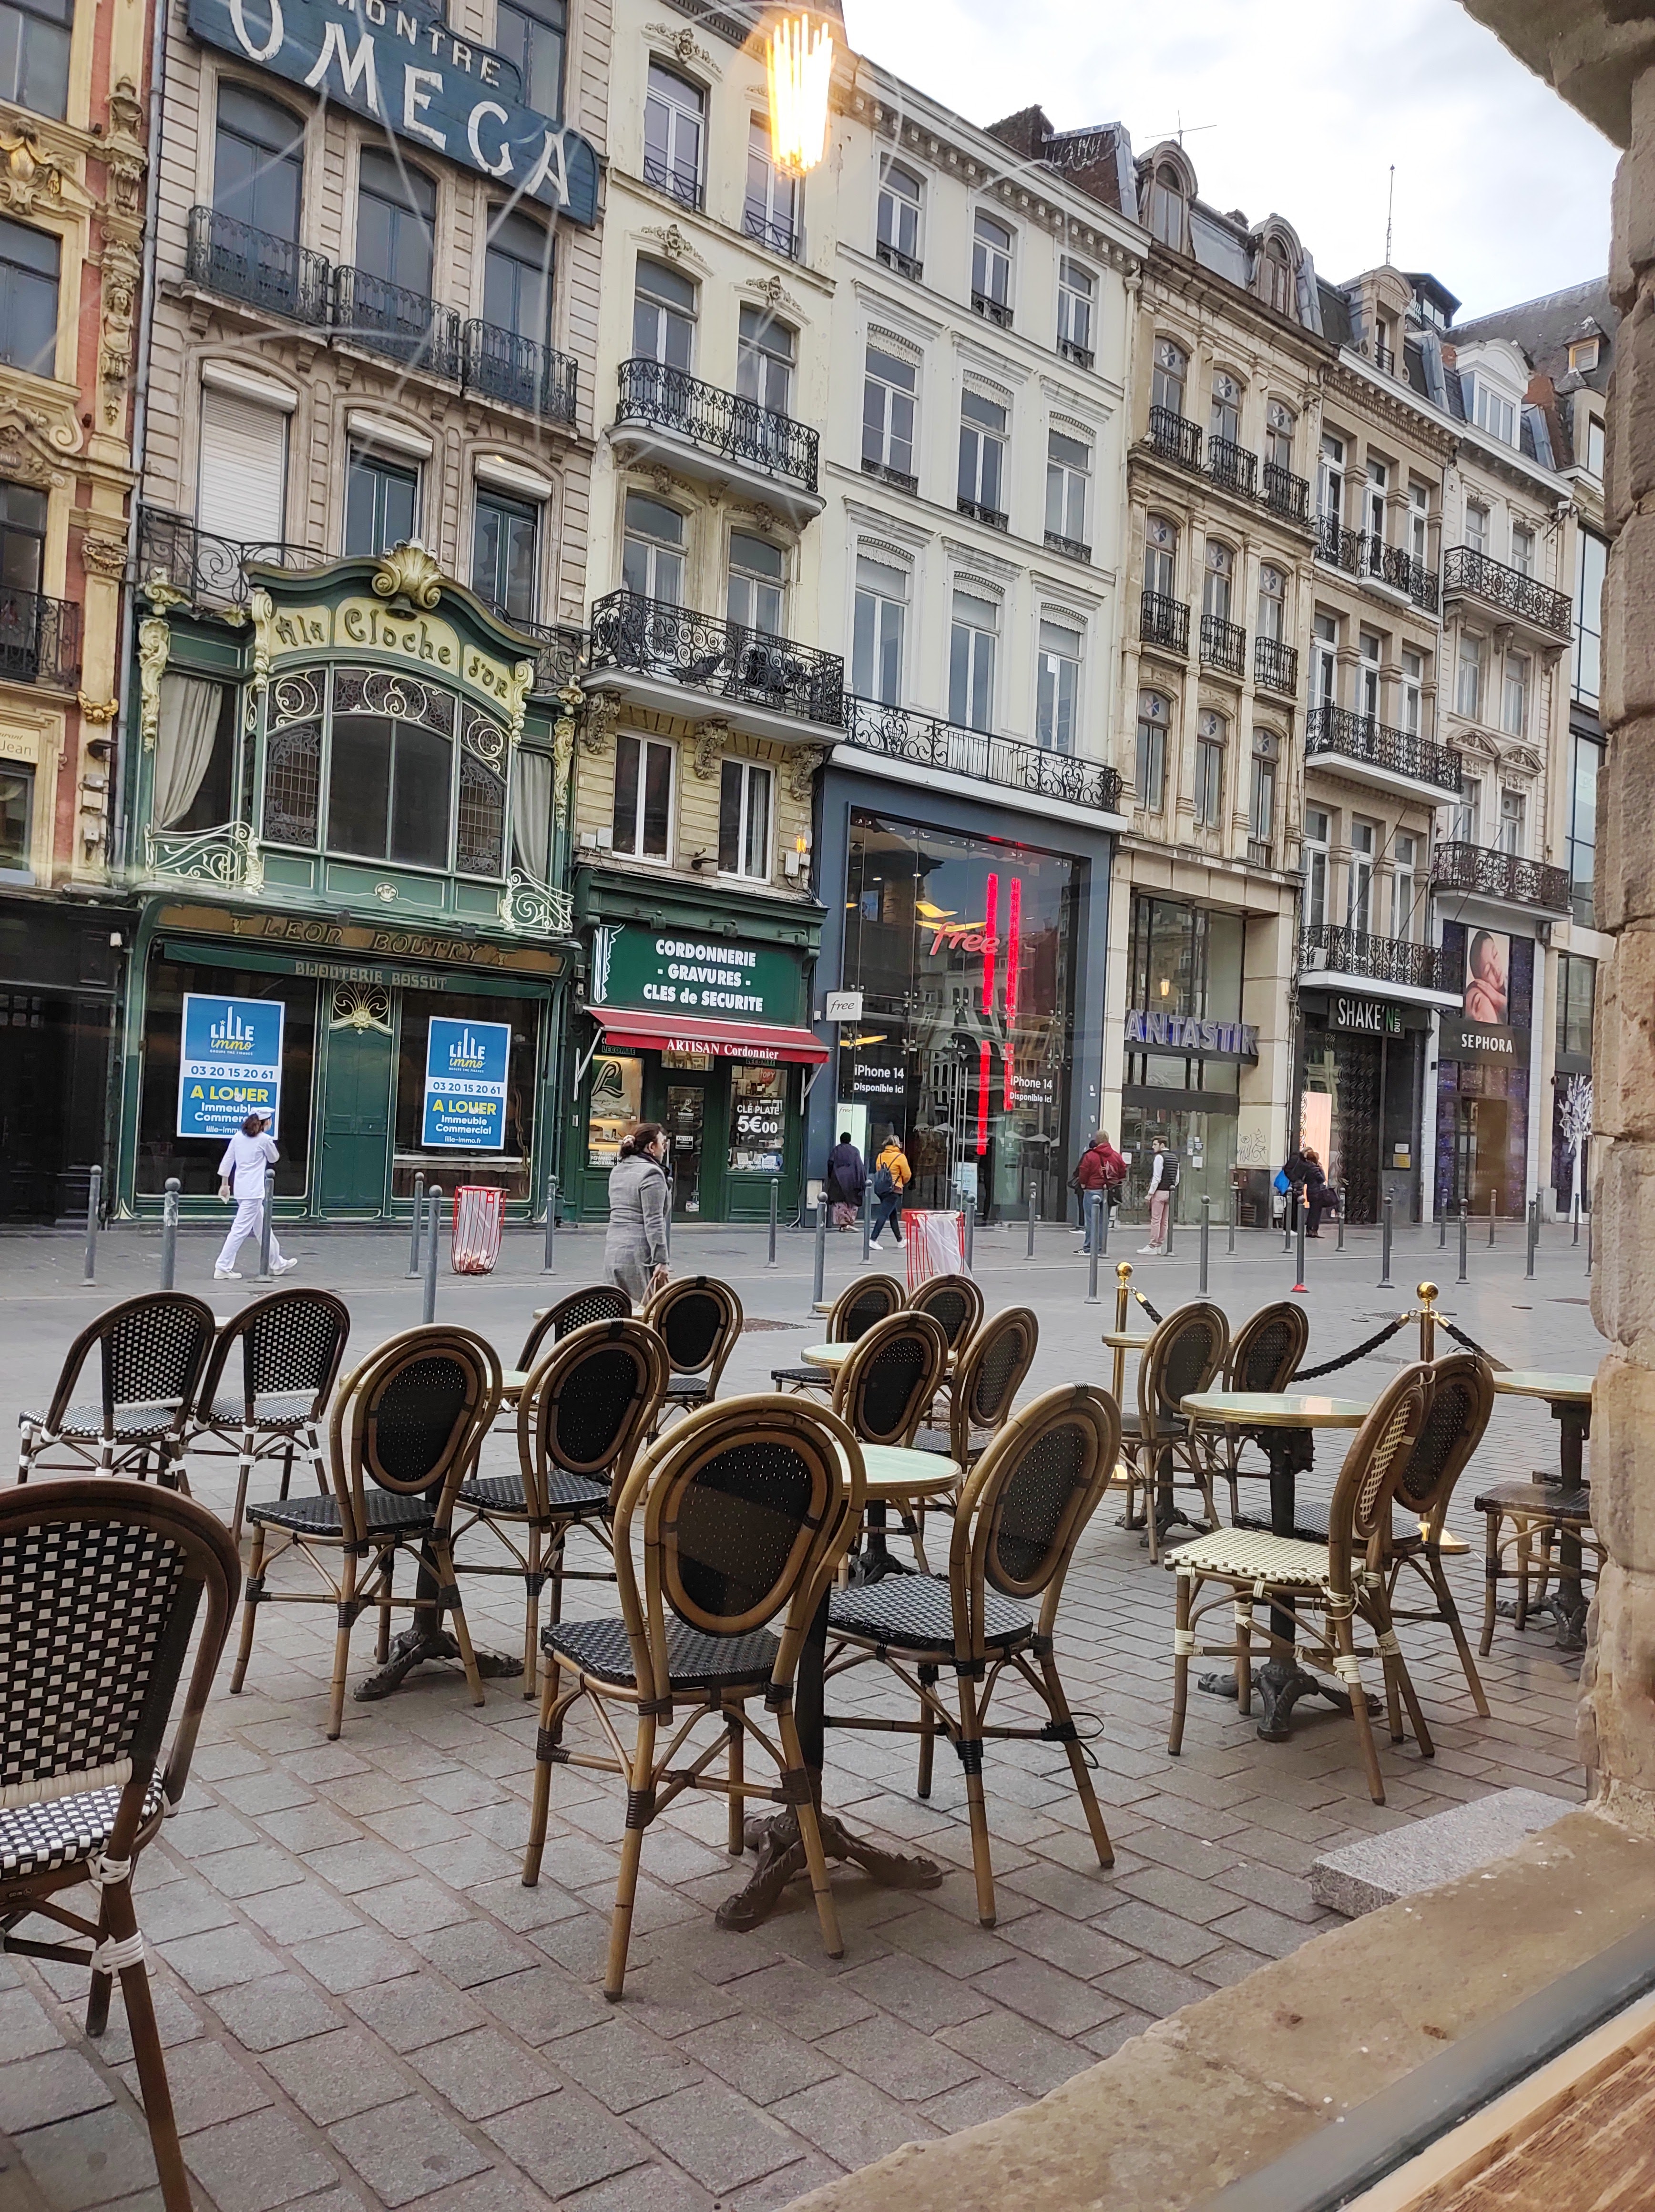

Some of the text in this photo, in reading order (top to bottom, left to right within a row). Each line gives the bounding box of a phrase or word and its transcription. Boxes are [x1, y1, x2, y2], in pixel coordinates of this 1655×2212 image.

[230, 0, 572, 206] OMEGA
[345, 608, 451, 665] Cloche
[263, 916, 484, 961] LEON BOUTRY
[930, 921, 1001, 956] free
[655, 939, 756, 967] CORDONNERIE
[295, 961, 447, 990] BIJOUTERIE BOSSUT
[668, 963, 742, 987] GRAVURES
[643, 983, 763, 1012] CLES de SECURITE
[830, 1000, 855, 1014] free
[1124, 1009, 1259, 1056] ANTASTIK
[211, 1039, 255, 1051] immo
[601, 1045, 636, 1055] LECOMTE
[666, 1039, 779, 1060] ARTISAN Cordonnier
[1461, 1034, 1513, 1053] SEPHORA
[450, 1058, 486, 1068] immo
[746, 1058, 776, 1067] LECOMTE
[191, 1065, 273, 1079] 03 20 15 20 61
[854, 1064, 904, 1079] iPhone 14
[433, 1082, 501, 1095] 03 20 15 20 61
[854, 1082, 904, 1094] Disponible ici
[1011, 1075, 1052, 1090] iPhone 14
[190, 1085, 269, 1103] A LOUER
[1009, 1092, 1052, 1104] Disponible ici
[201, 1102, 253, 1113] Immeubl
[432, 1099, 497, 1116] A LOUER
[737, 1103, 780, 1115] CLÉ PLATE
[194, 1112, 246, 1123] Commer
[441, 1115, 487, 1126] Immeuble
[737, 1115, 778, 1134] 5€00
[206, 1126, 239, 1134] lille-imm
[435, 1123, 491, 1135] Commercial
[445, 1136, 481, 1144] lille-immo.fr
